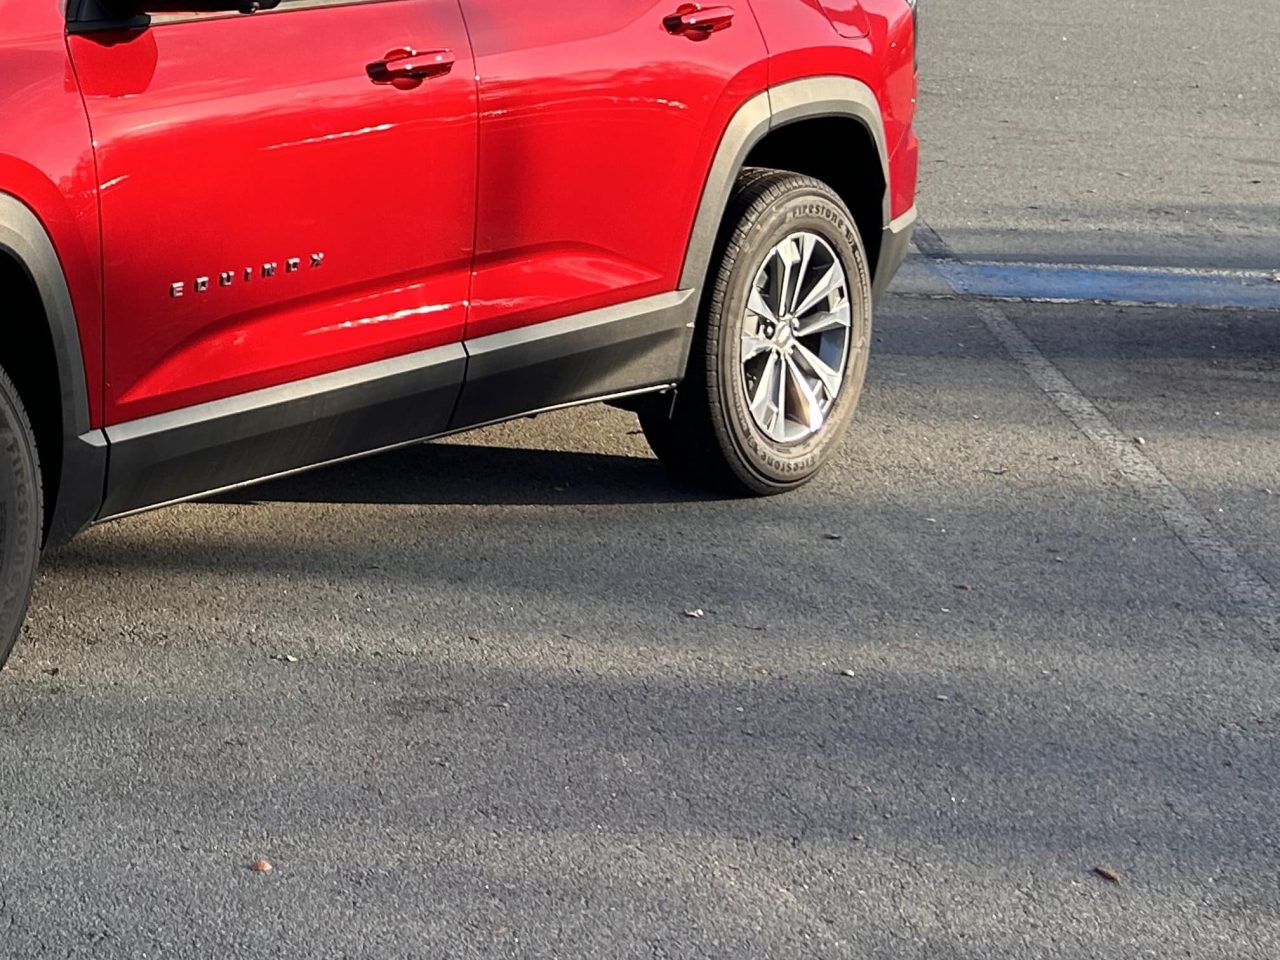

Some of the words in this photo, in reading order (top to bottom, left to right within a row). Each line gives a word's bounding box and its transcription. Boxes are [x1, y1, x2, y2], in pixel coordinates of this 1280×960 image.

[792, 203, 844, 229] Firestone
[170, 252, 325, 297] EQUINOX
[760, 450, 817, 473] Firestone
[6, 434, 33, 588] Firestone
